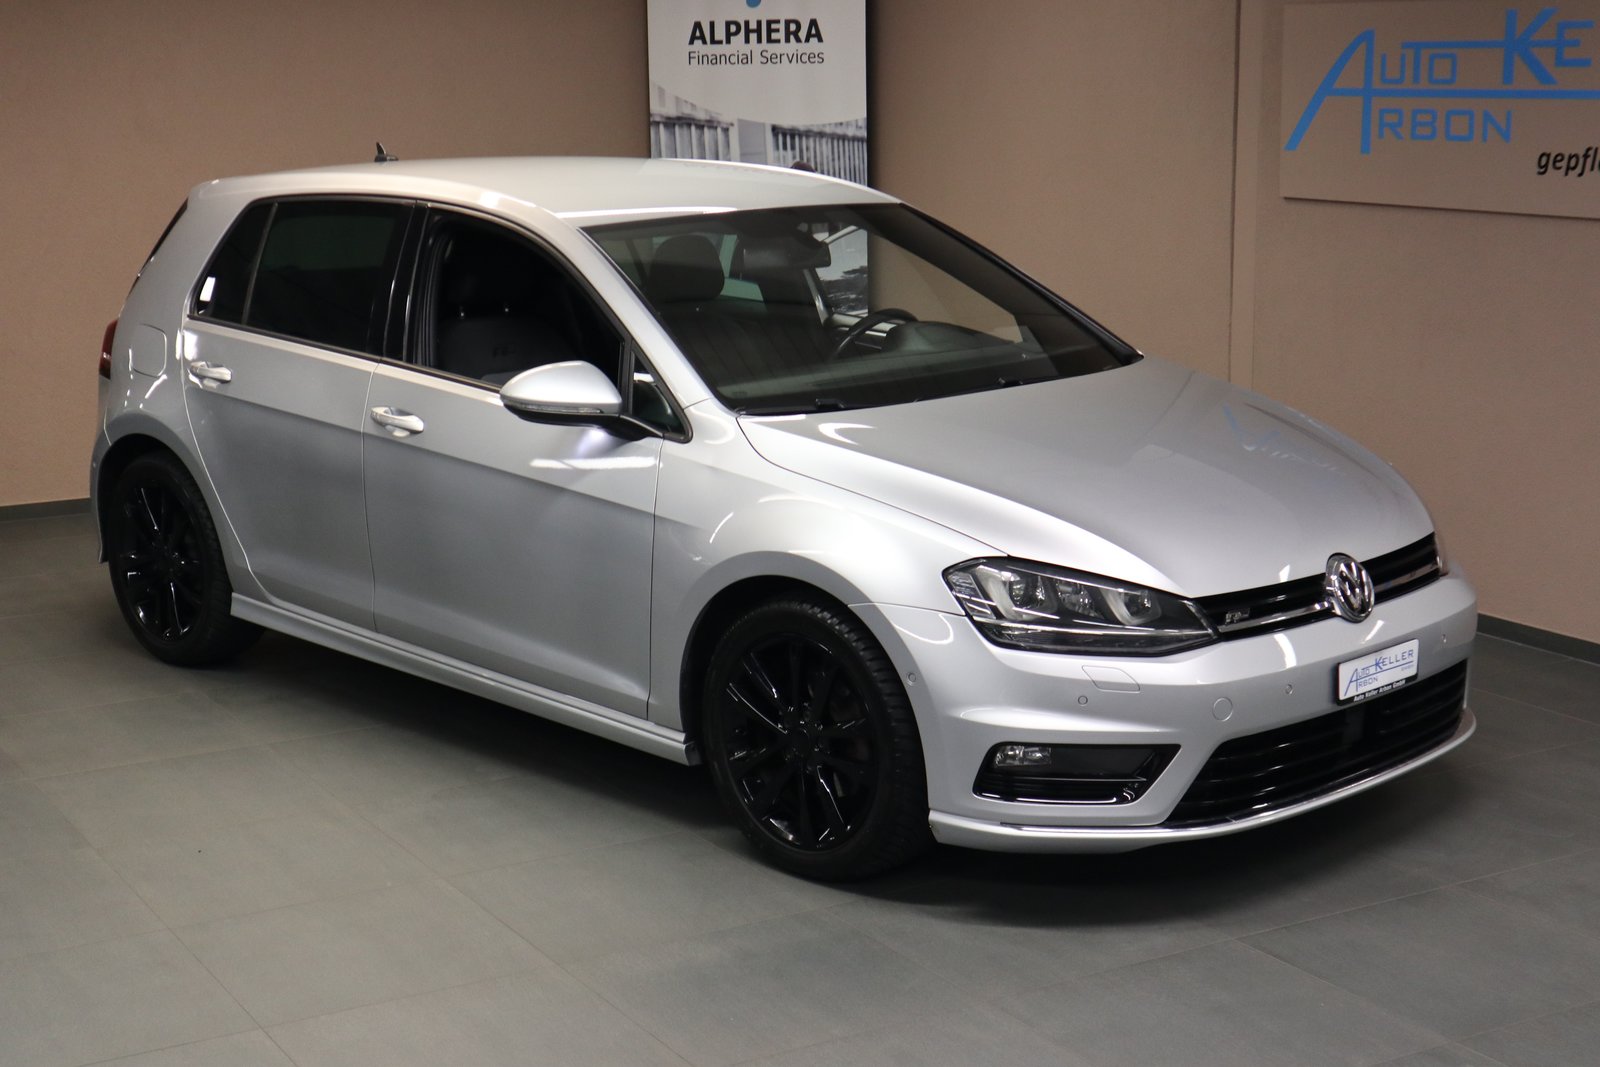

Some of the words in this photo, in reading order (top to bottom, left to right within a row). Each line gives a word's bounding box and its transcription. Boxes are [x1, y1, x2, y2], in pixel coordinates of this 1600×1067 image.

[688, 18, 824, 46] ALPHERA
[688, 50, 753, 66] Financial
[760, 49, 825, 65] Services
[1537, 147, 1600, 177] gepfl
[1375, 649, 1414, 672] KELLER
